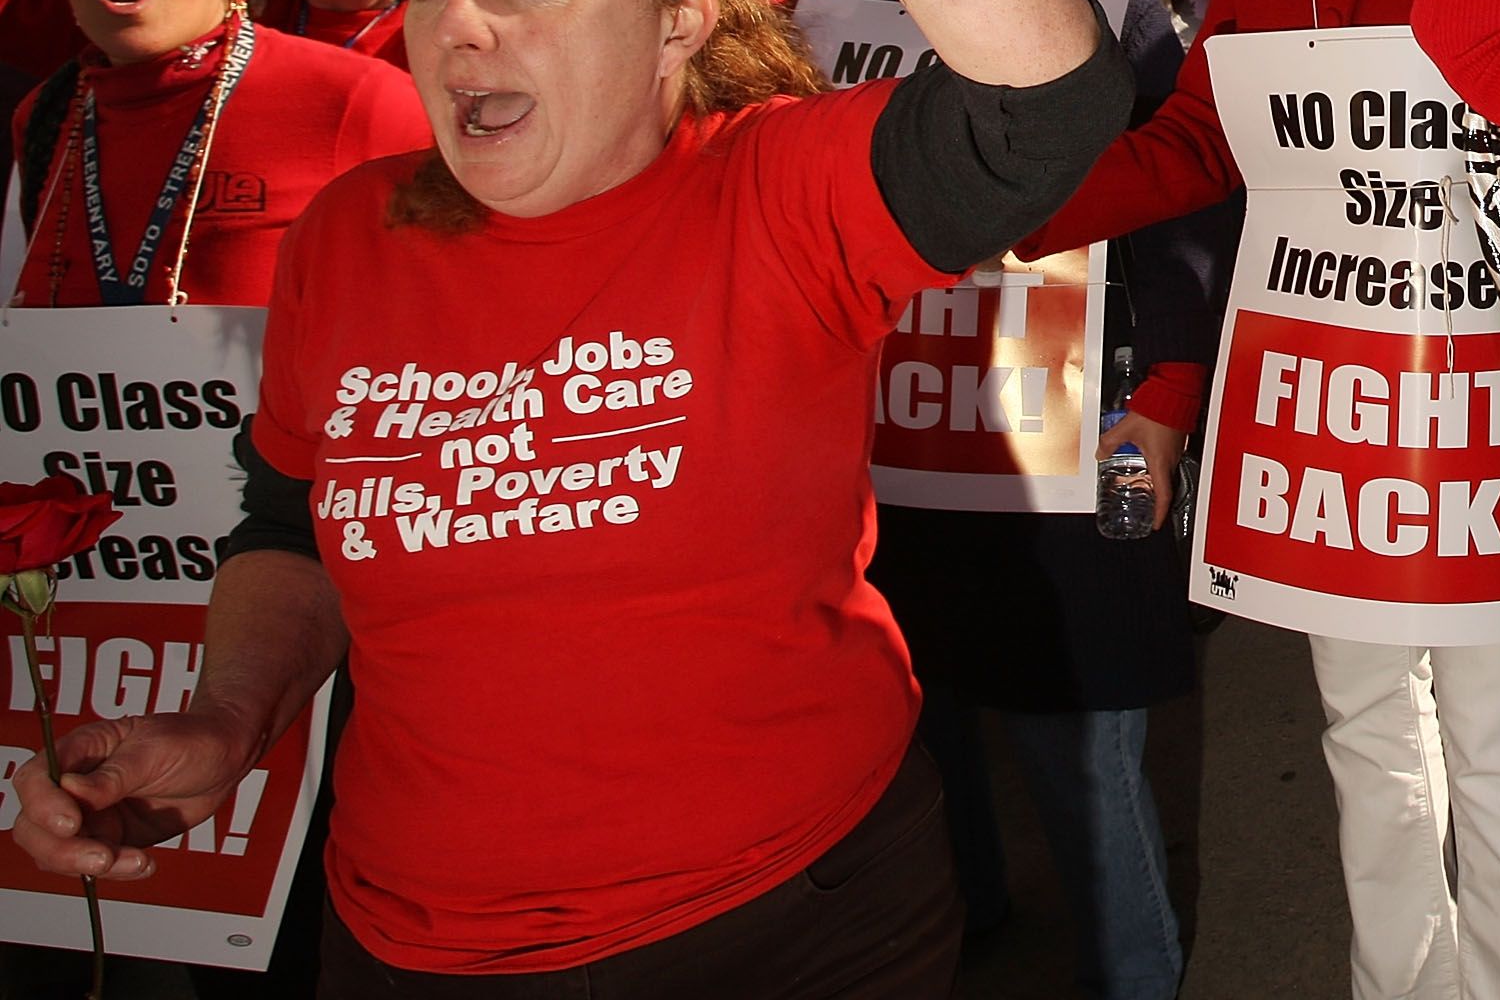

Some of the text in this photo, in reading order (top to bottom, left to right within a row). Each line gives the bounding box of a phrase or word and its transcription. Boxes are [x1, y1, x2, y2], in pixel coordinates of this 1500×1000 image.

[832, 42, 903, 84] NO
[1268, 90, 1466, 151] NO Cla
[83, 137, 119, 283] ELEMENTARY
[127, 223, 160, 288] SOTO
[157, 127, 202, 210] STREET
[1338, 168, 1444, 230] Size
[1266, 236, 1498, 311] Increase
[543, 331, 675, 376] Jobs
[0, 372, 242, 432] O Class
[324, 368, 693, 440] & Health Care
[440, 421, 536, 470] not
[317, 444, 684, 521] Jails, Poverty
[341, 494, 640, 561] & Warfare
[1210, 583, 1235, 599] UTLA
[7, 635, 205, 721] FIGH
